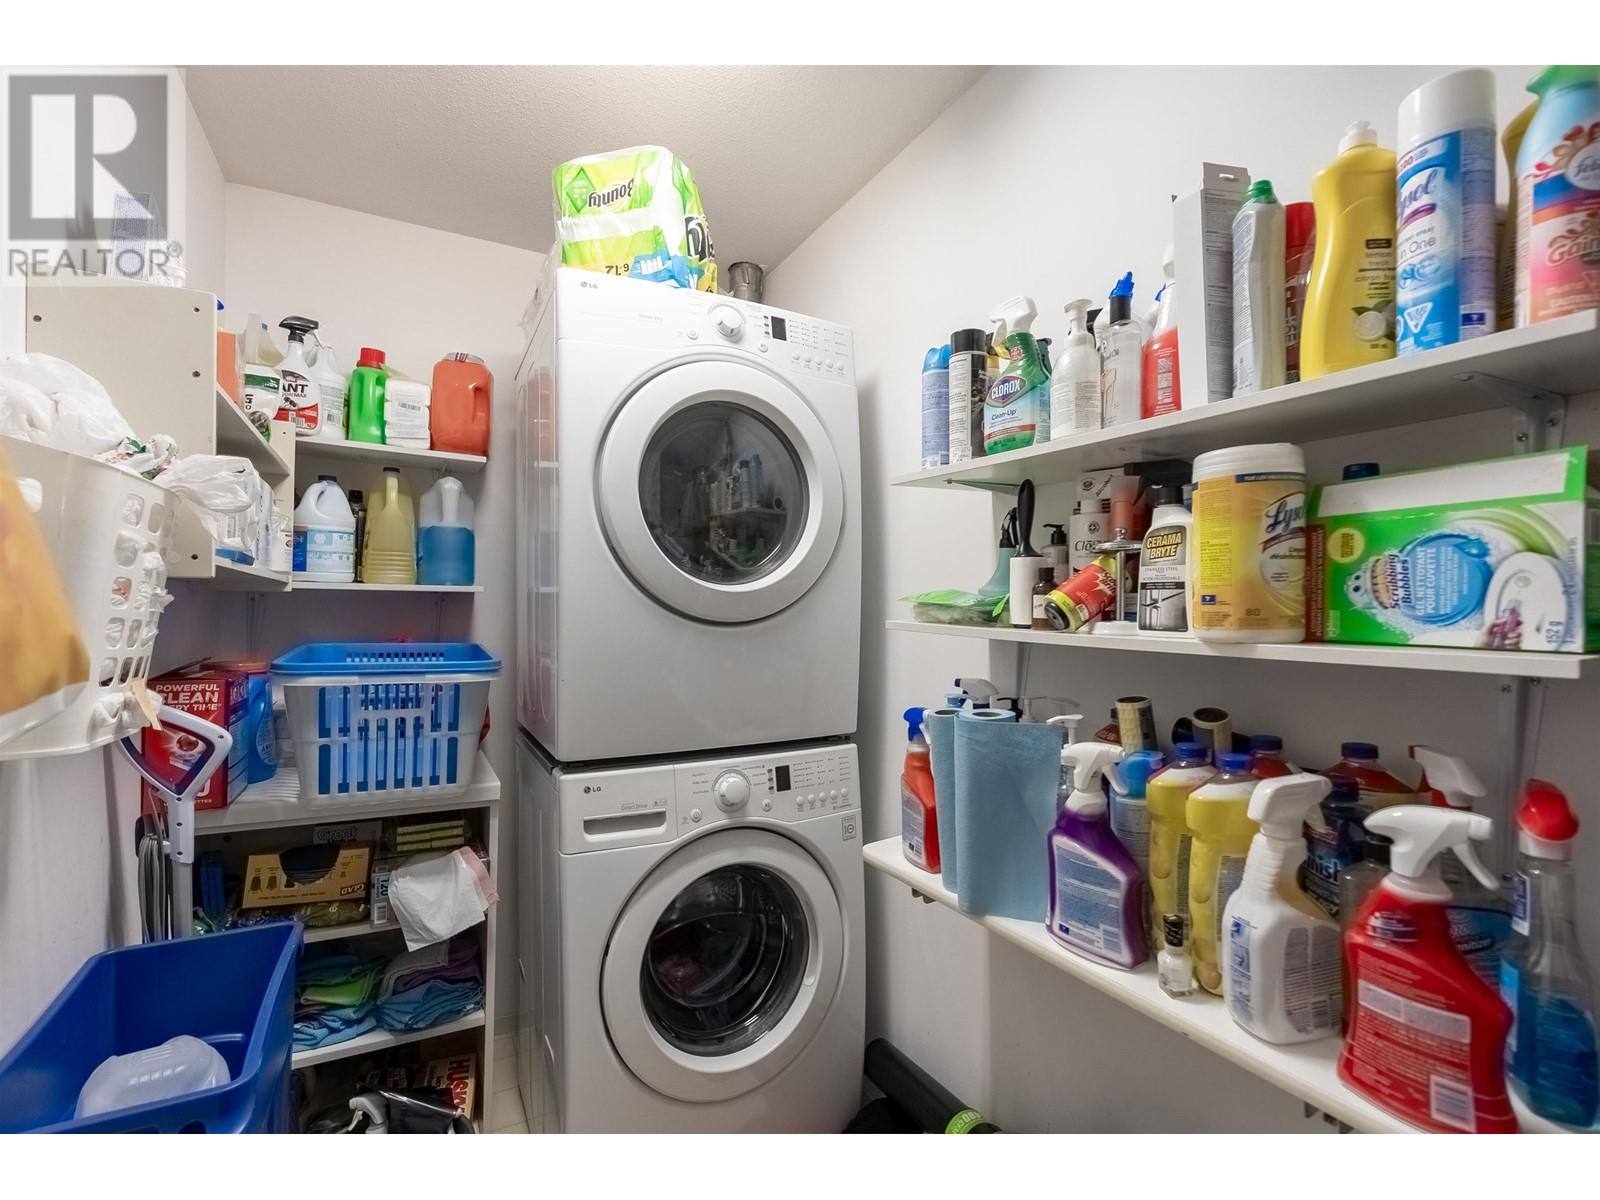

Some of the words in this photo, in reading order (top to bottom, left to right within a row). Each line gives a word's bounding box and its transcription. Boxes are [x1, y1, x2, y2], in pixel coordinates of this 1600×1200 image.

[588, 177, 635, 208] Bounty
[1398, 168, 1439, 219] ysol
[1408, 236, 1437, 254] One
[991, 379, 1021, 399] CLOROX
[991, 408, 1017, 421] Clean-Up
[1146, 532, 1182, 549] CERAMA
[1149, 544, 1178, 560] BRYTE
[1415, 546, 1425, 597] NETTOYANT
[1426, 548, 1436, 587] CUVETTE
[1385, 554, 1400, 609] Scrubbing
[1398, 559, 1412, 604] Bubbles
[1415, 599, 1425, 615] GEL
[1426, 588, 1436, 613] POUR
[1545, 629, 1561, 644] 152
[155, 683, 220, 692] POWERFUL
[340, 882, 365, 897] GLAD
